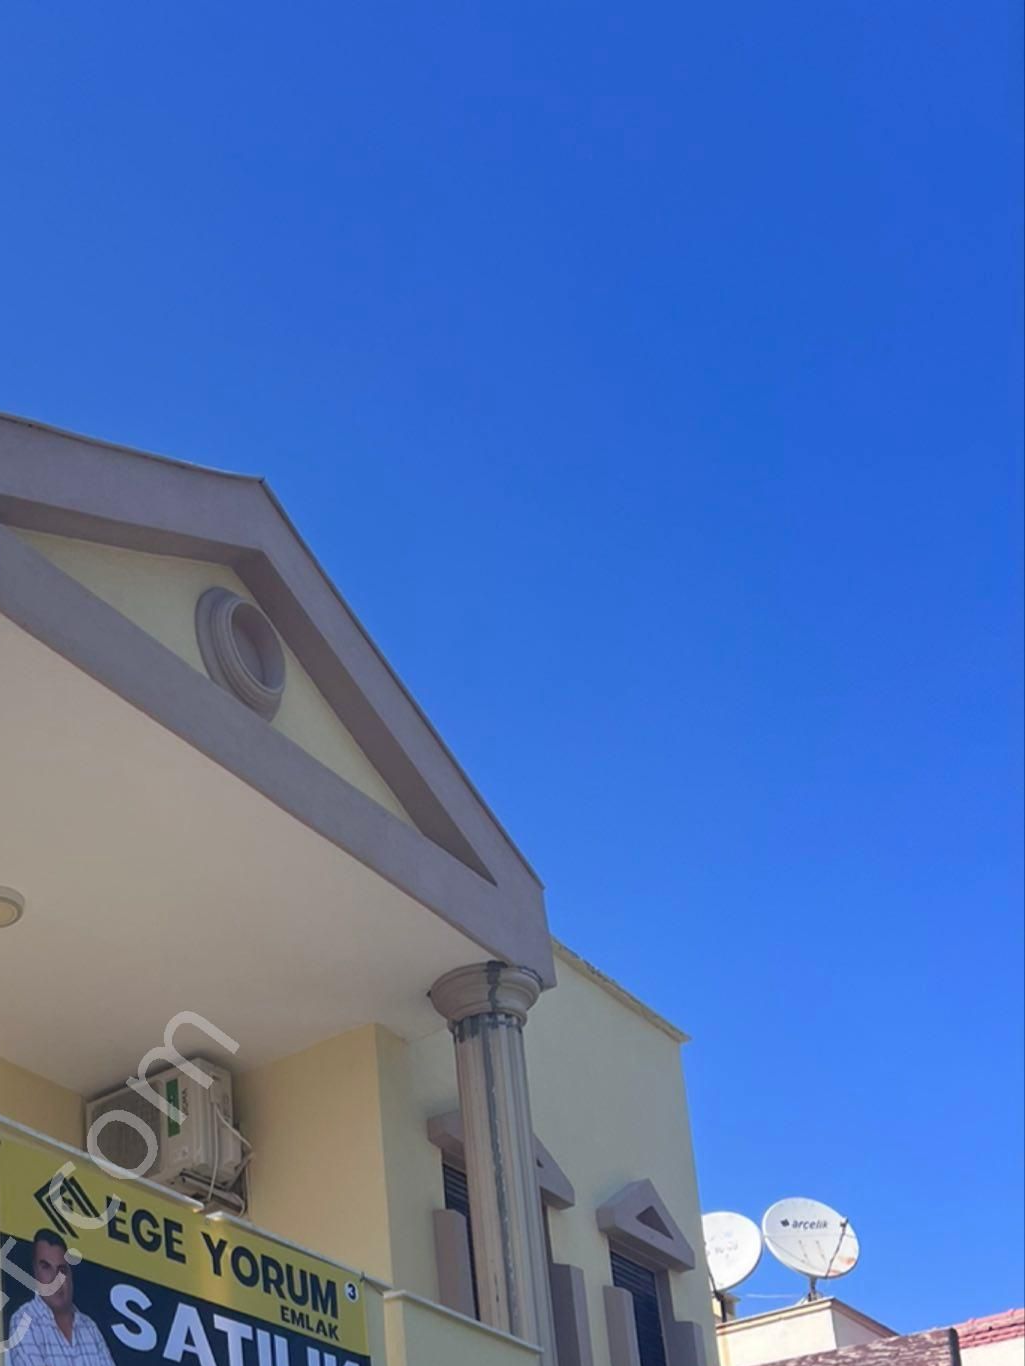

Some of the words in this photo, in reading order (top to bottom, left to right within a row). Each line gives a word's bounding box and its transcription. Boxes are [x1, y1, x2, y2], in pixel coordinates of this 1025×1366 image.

[105, 1195, 186, 1265] EGE
[200, 1231, 339, 1320] YORUM
[280, 1305, 340, 1342] EMLAK
